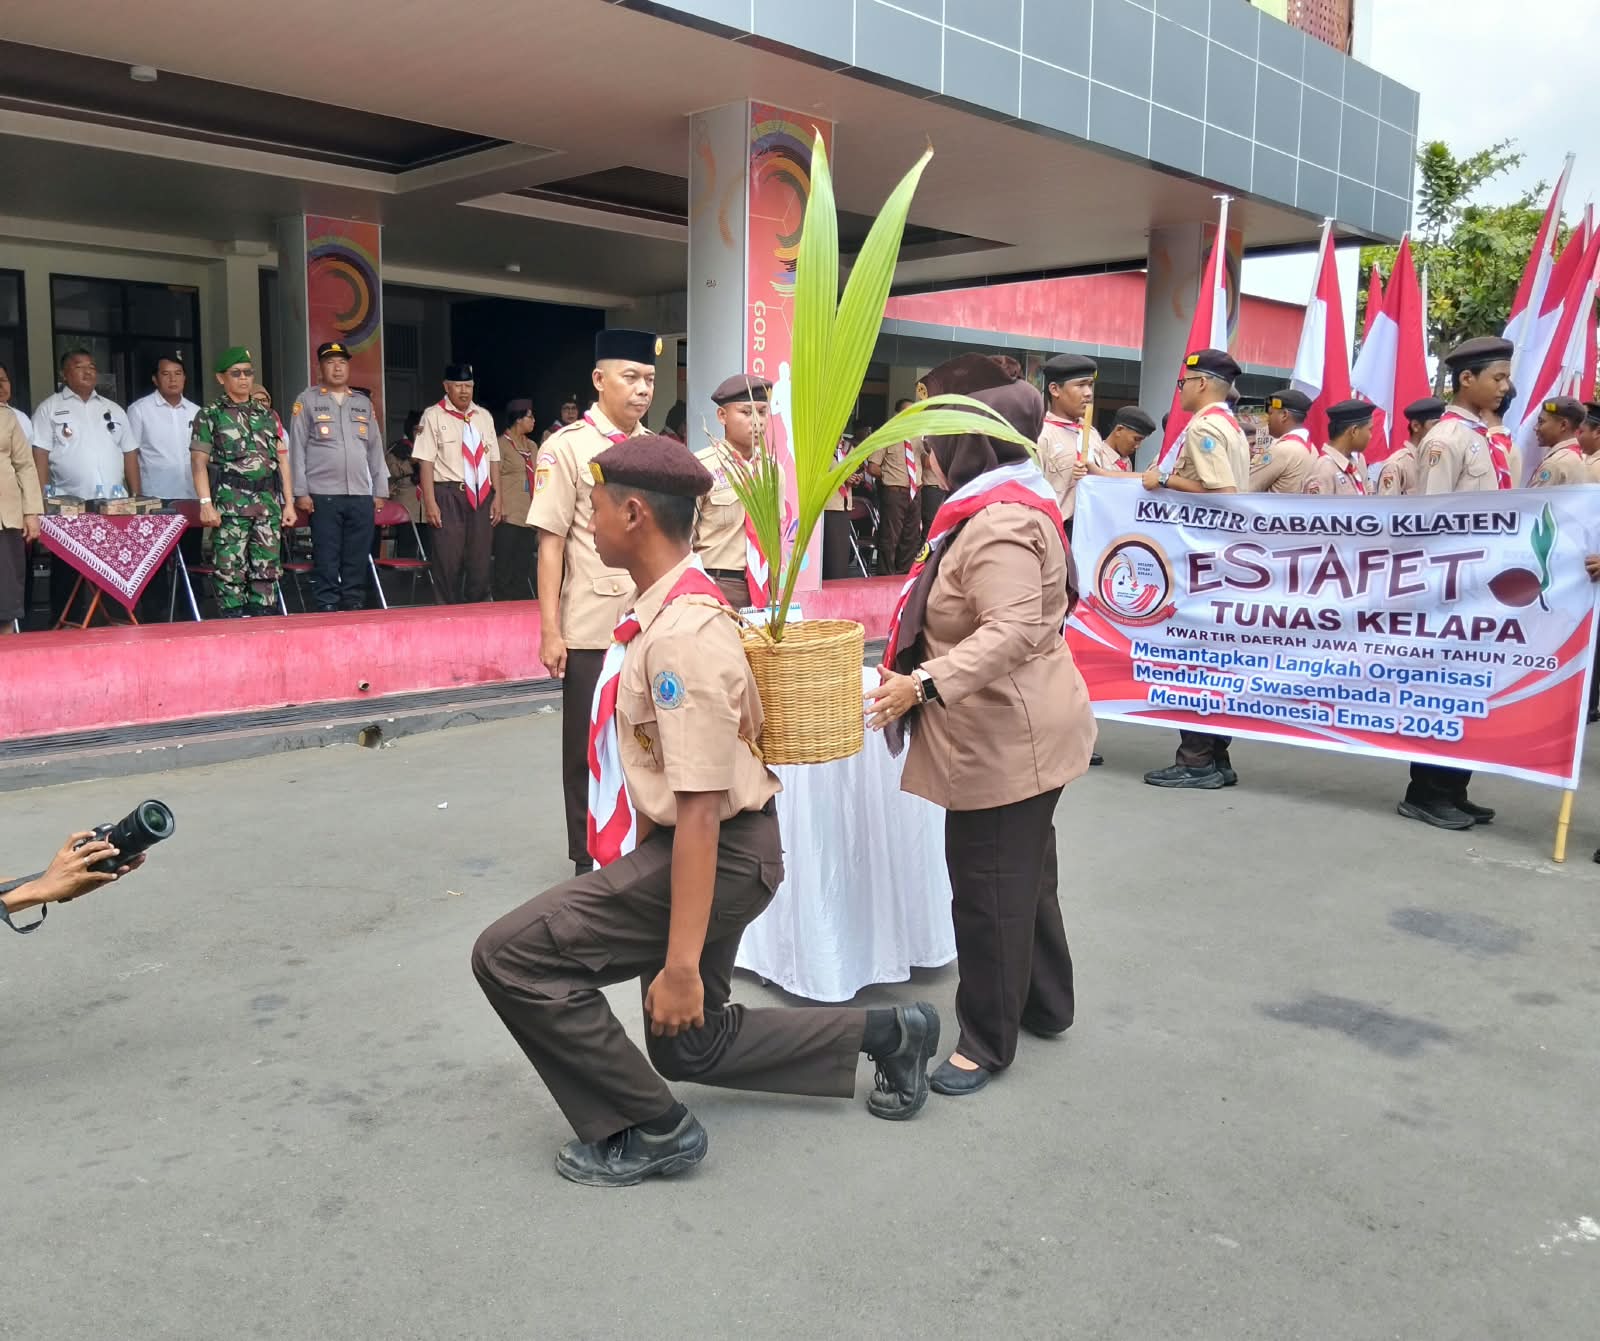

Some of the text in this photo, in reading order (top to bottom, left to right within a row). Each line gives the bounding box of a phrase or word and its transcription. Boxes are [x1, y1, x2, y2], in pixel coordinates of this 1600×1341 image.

[753, 300, 766, 352] GOR
[1136, 501, 1517, 534] KWARTIR CABANG KLATEN
[1187, 542, 1485, 601] ESTAFET
[1210, 600, 1527, 645] TUNAS KELAPA
[1133, 642, 1493, 689] Memantapkan Langkah Organisasi
[1165, 626, 1558, 670] KWARTIR DAERAH JAWA TENGAH TAHUN 2026
[1135, 664, 1485, 715] Mendukung Swasembada Pangan
[1150, 688, 1460, 738] Menuju Indonesia Emas 2045
